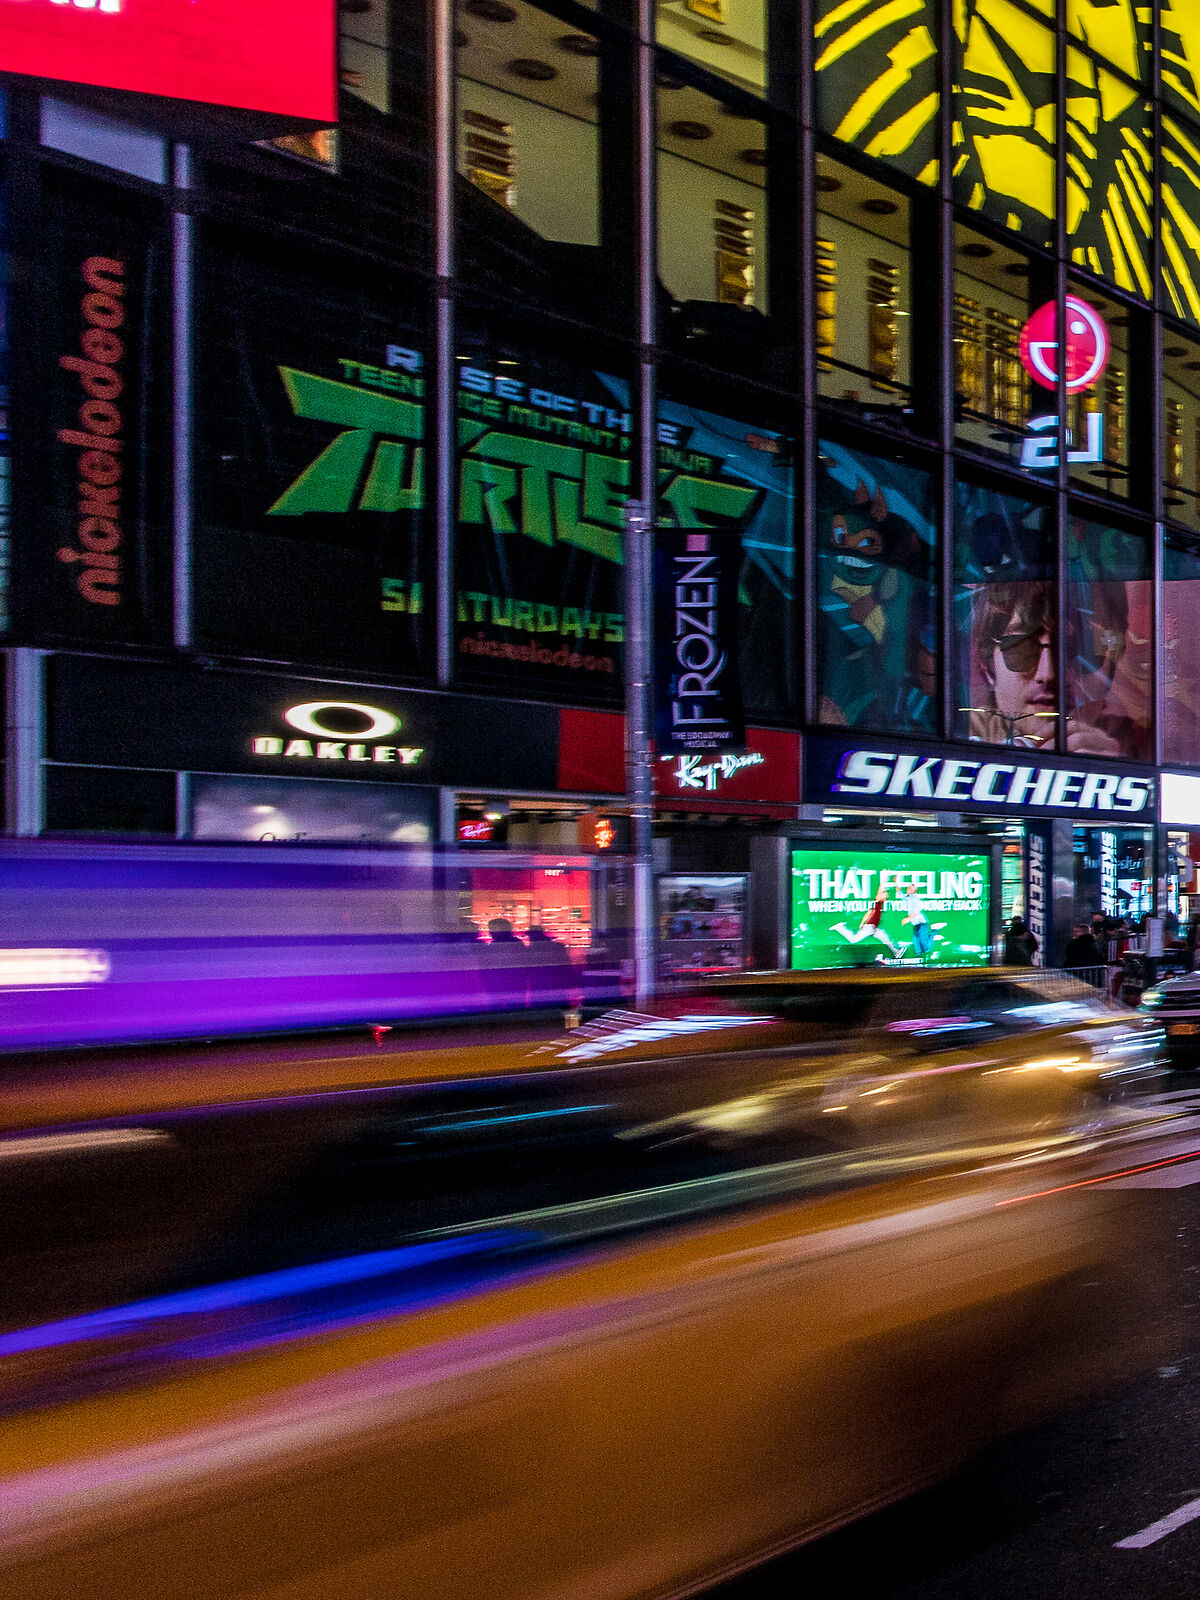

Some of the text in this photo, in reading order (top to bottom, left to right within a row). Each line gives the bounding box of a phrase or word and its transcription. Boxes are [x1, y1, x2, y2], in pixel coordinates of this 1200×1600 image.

[386, 344, 527, 401] RSE
[56, 256, 127, 605] nickelodeon
[671, 556, 730, 726] FROZEN
[252, 736, 424, 764] OAKLEY
[831, 750, 1152, 812] SKECHERS
[802, 868, 877, 899] THAT
